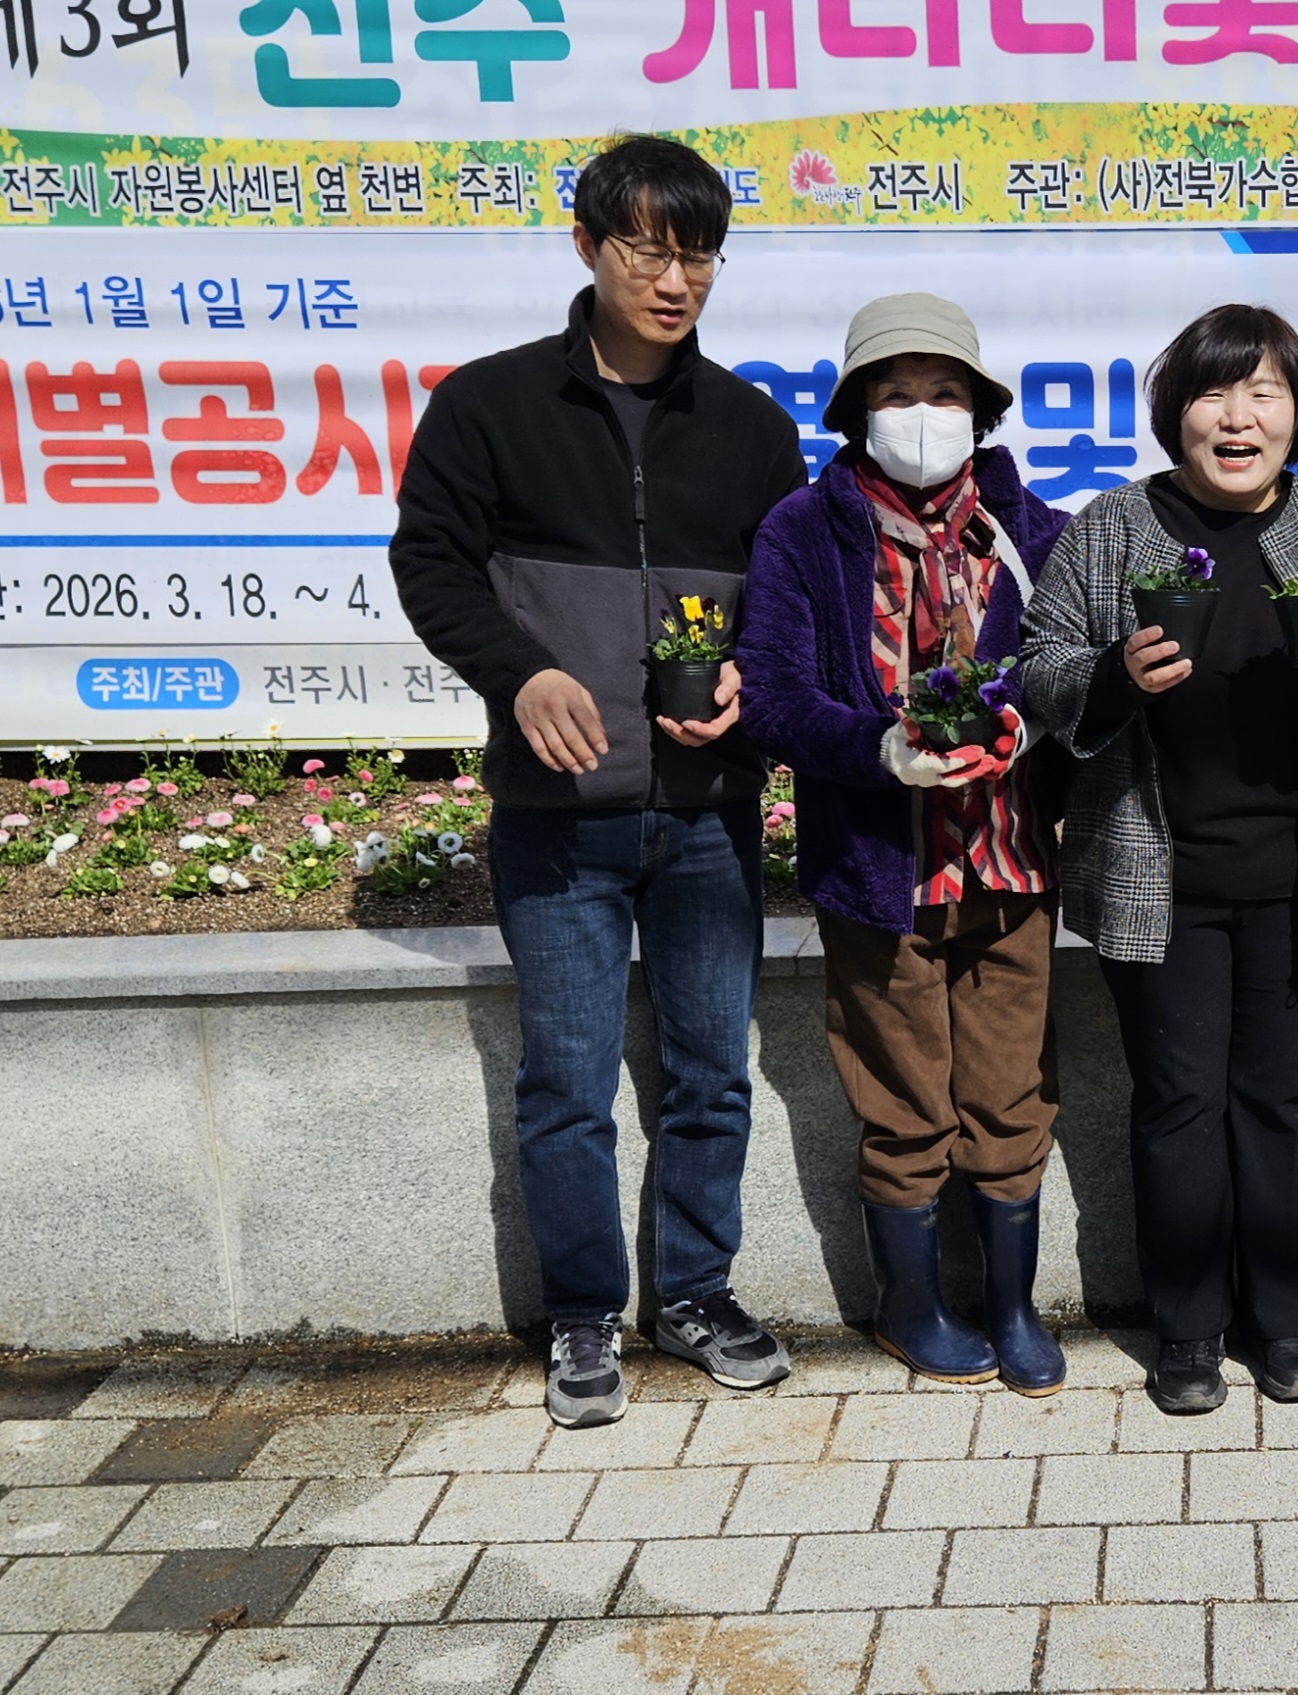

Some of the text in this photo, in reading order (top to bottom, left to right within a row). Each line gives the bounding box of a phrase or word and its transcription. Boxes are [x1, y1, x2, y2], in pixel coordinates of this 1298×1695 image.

[2, 166, 98, 214] 전주시
[109, 164, 302, 215] 자원봉사센터
[316, 164, 347, 214] 옆
[360, 165, 424, 213] 천변
[458, 165, 537, 214] 주최:
[868, 162, 963, 212] 전주시
[1007, 162, 1082, 211] 주관:
[0, 275, 360, 330] 년 1월 1일 기준
[1020, 358, 1138, 502] 및
[43, 573, 150, 620] 2026.
[167, 573, 202, 620] 3.
[221, 573, 278, 620] 18.
[347, 573, 381, 620] 4.
[91, 665, 225, 704] 주최/주관
[263, 665, 369, 705] 전주시
